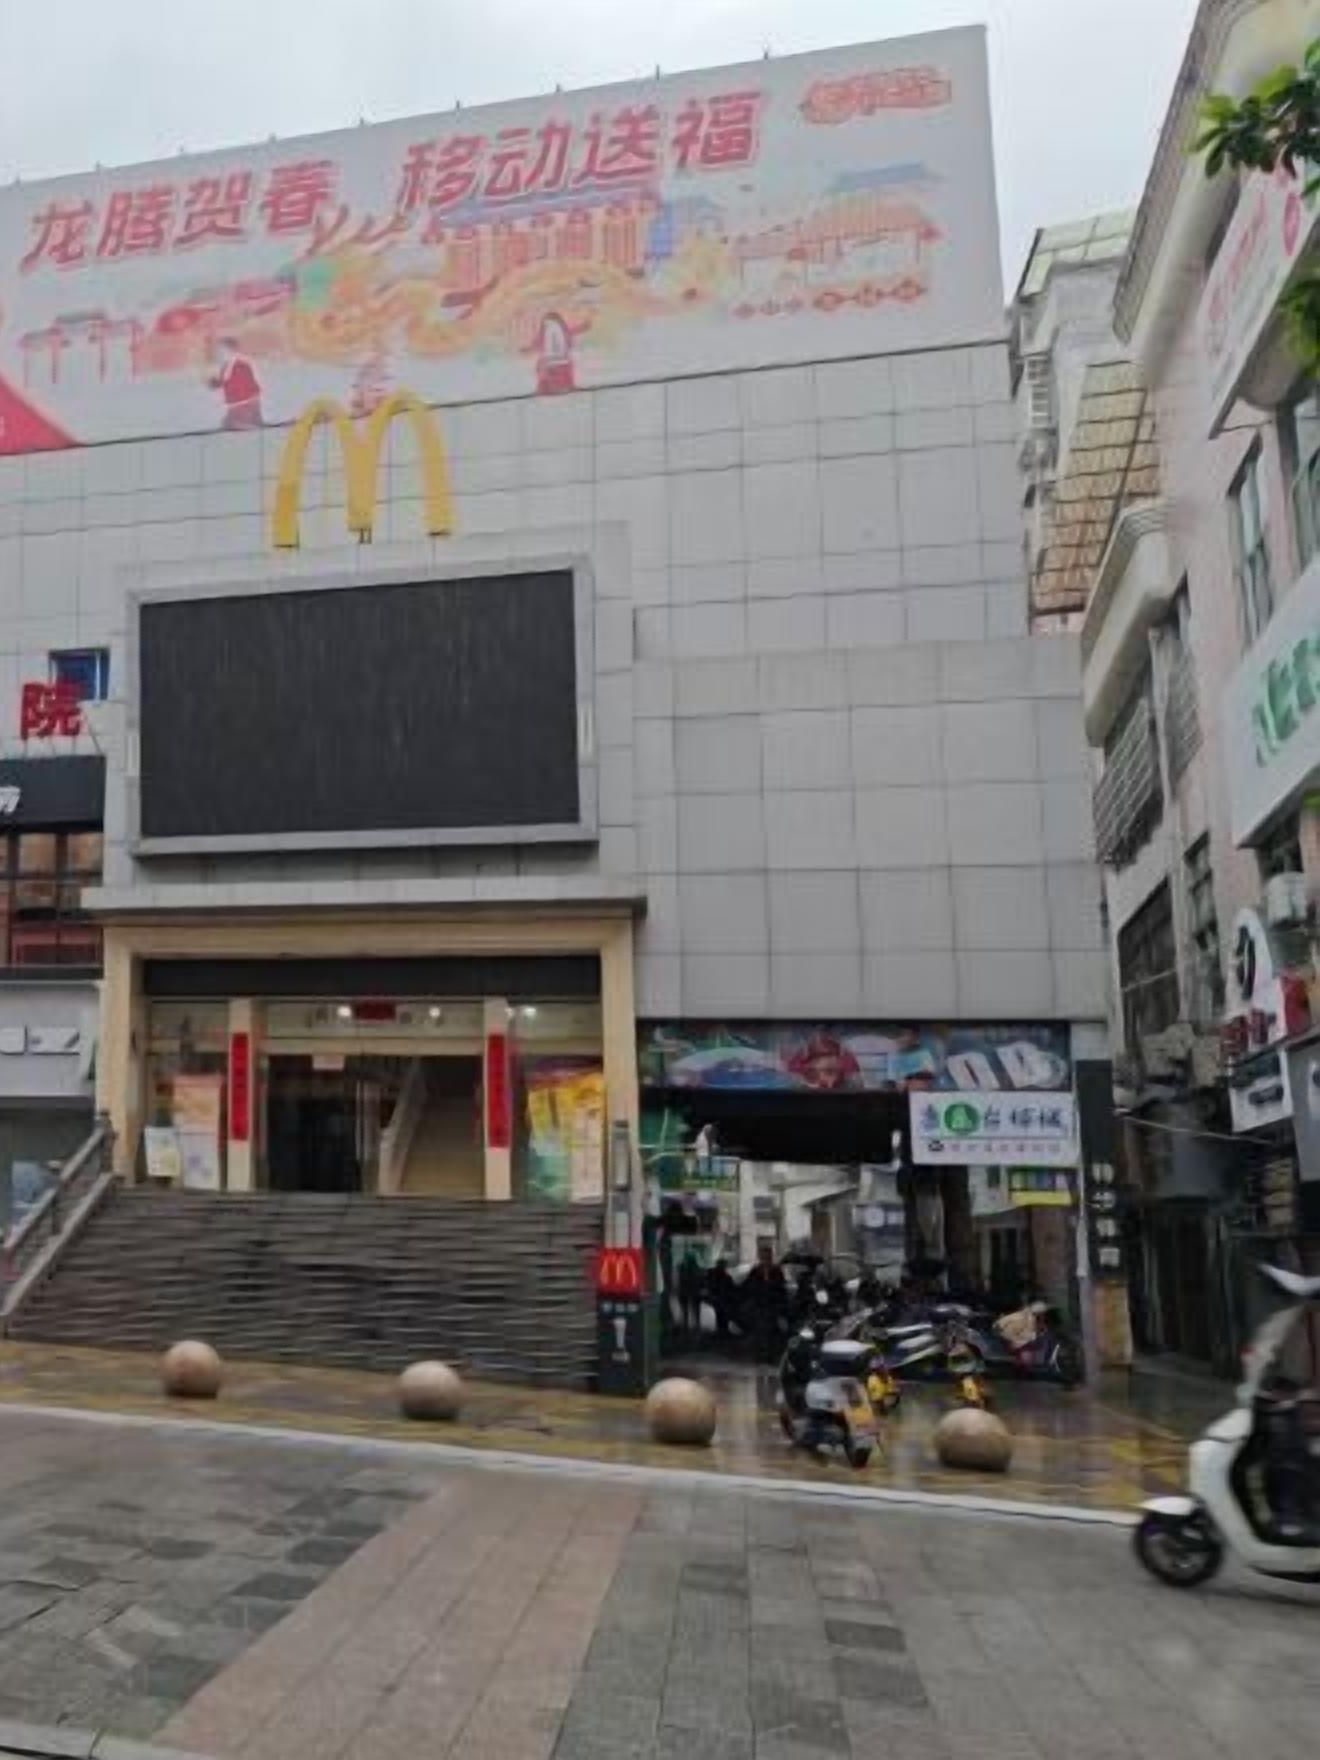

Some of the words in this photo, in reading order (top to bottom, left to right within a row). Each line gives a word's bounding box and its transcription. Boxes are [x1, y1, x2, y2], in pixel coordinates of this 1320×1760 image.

[397, 91, 764, 212] 移动送福
[20, 158, 335, 272] 龙腾贺春
